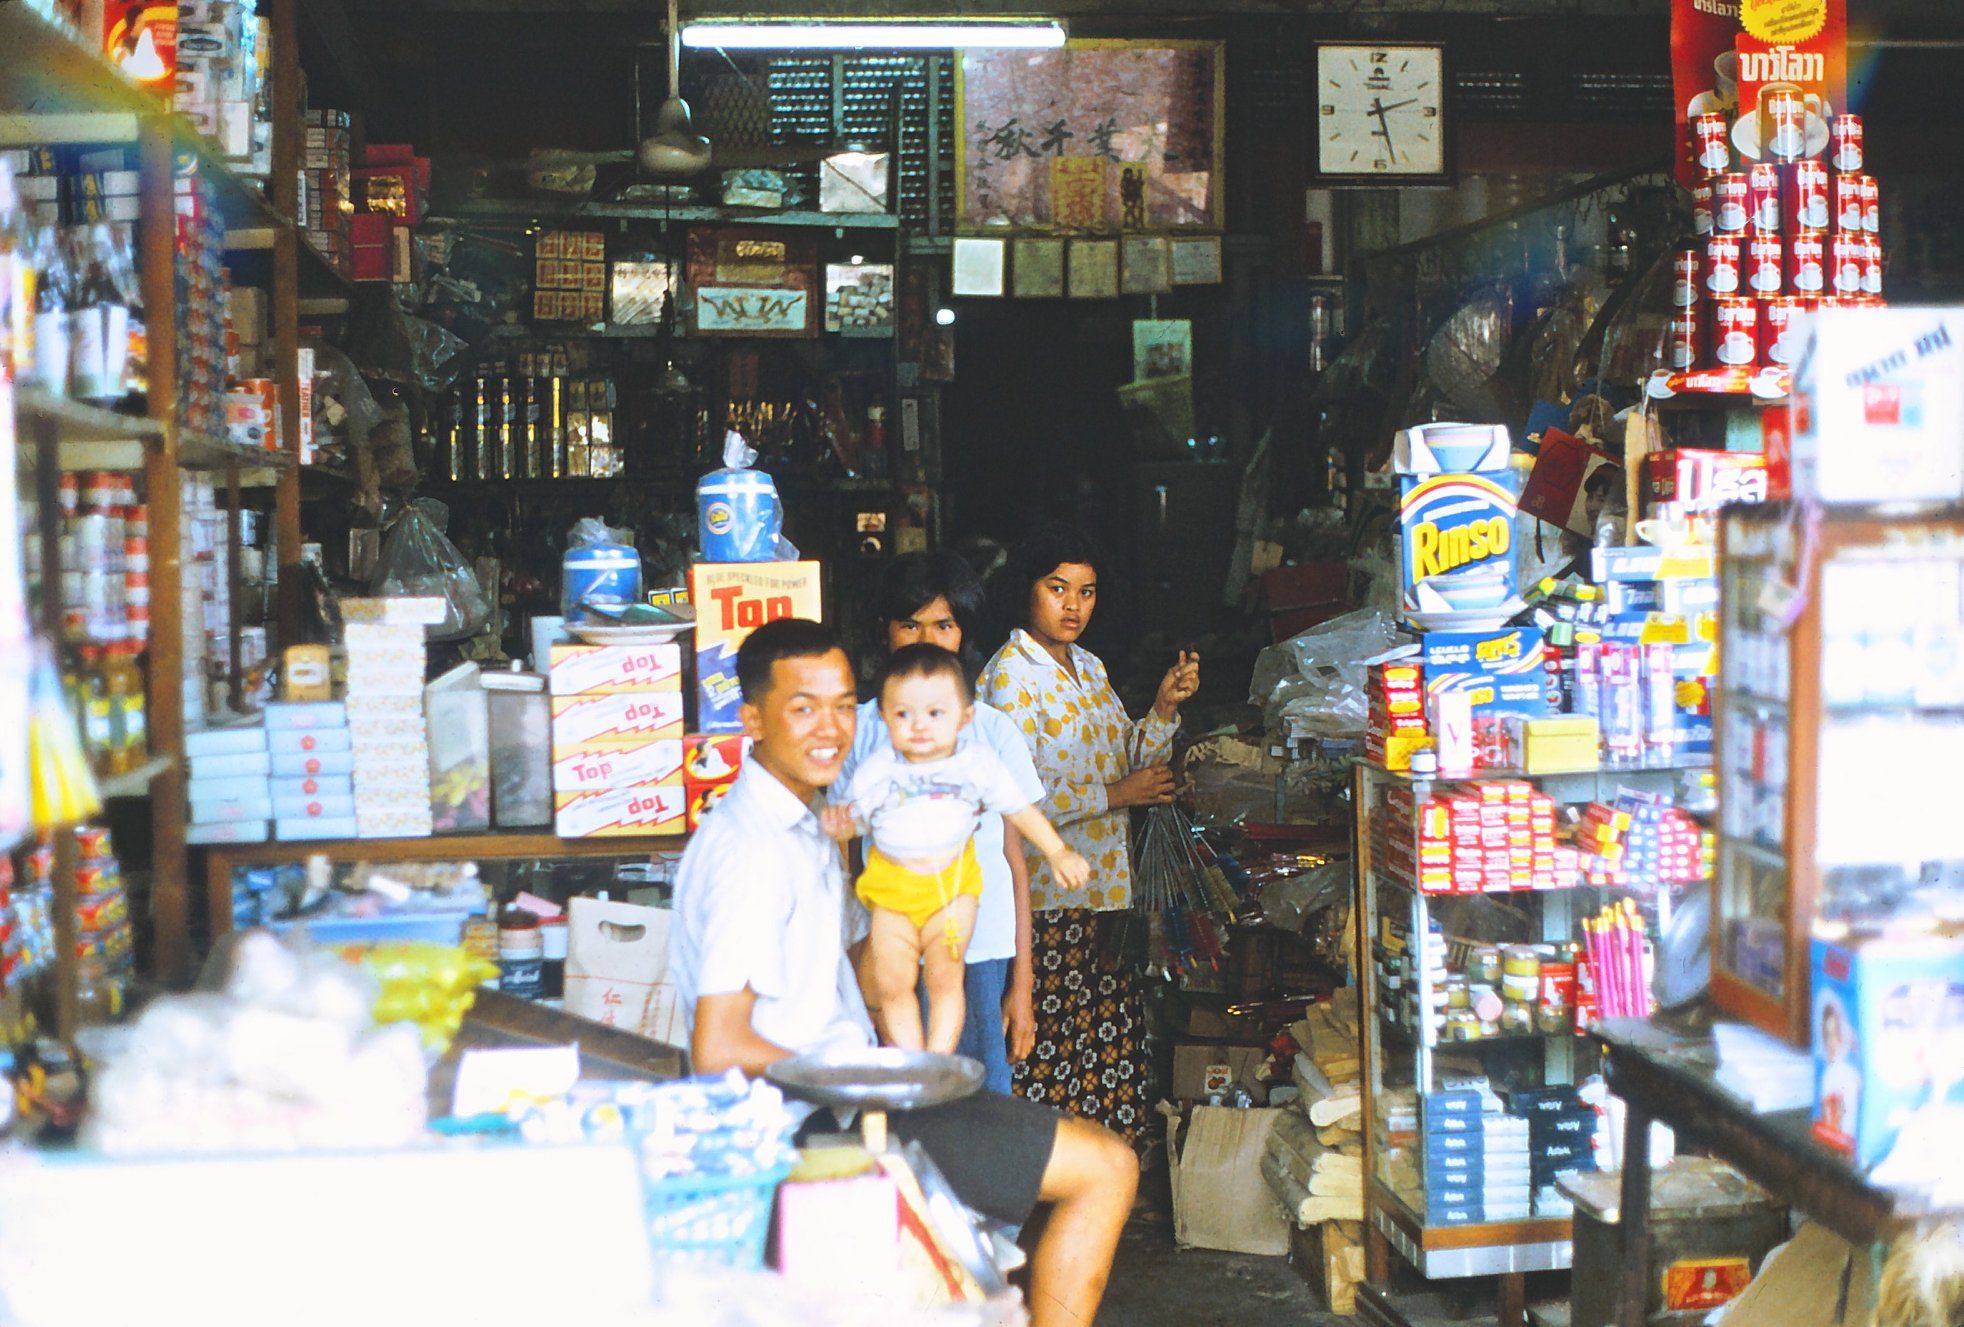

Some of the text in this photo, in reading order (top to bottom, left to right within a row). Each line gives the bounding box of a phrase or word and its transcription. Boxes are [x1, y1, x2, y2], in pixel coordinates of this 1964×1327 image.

[1371, 53, 1387, 63] 12
[1321, 105, 1335, 115] 9
[1423, 106, 1436, 117] 3
[1411, 516, 1510, 585] Rinso
[711, 585, 793, 631] Top
[622, 654, 662, 673] Top
[625, 704, 665, 721] Top
[572, 762, 612, 781] Top
[628, 795, 669, 814] Top
